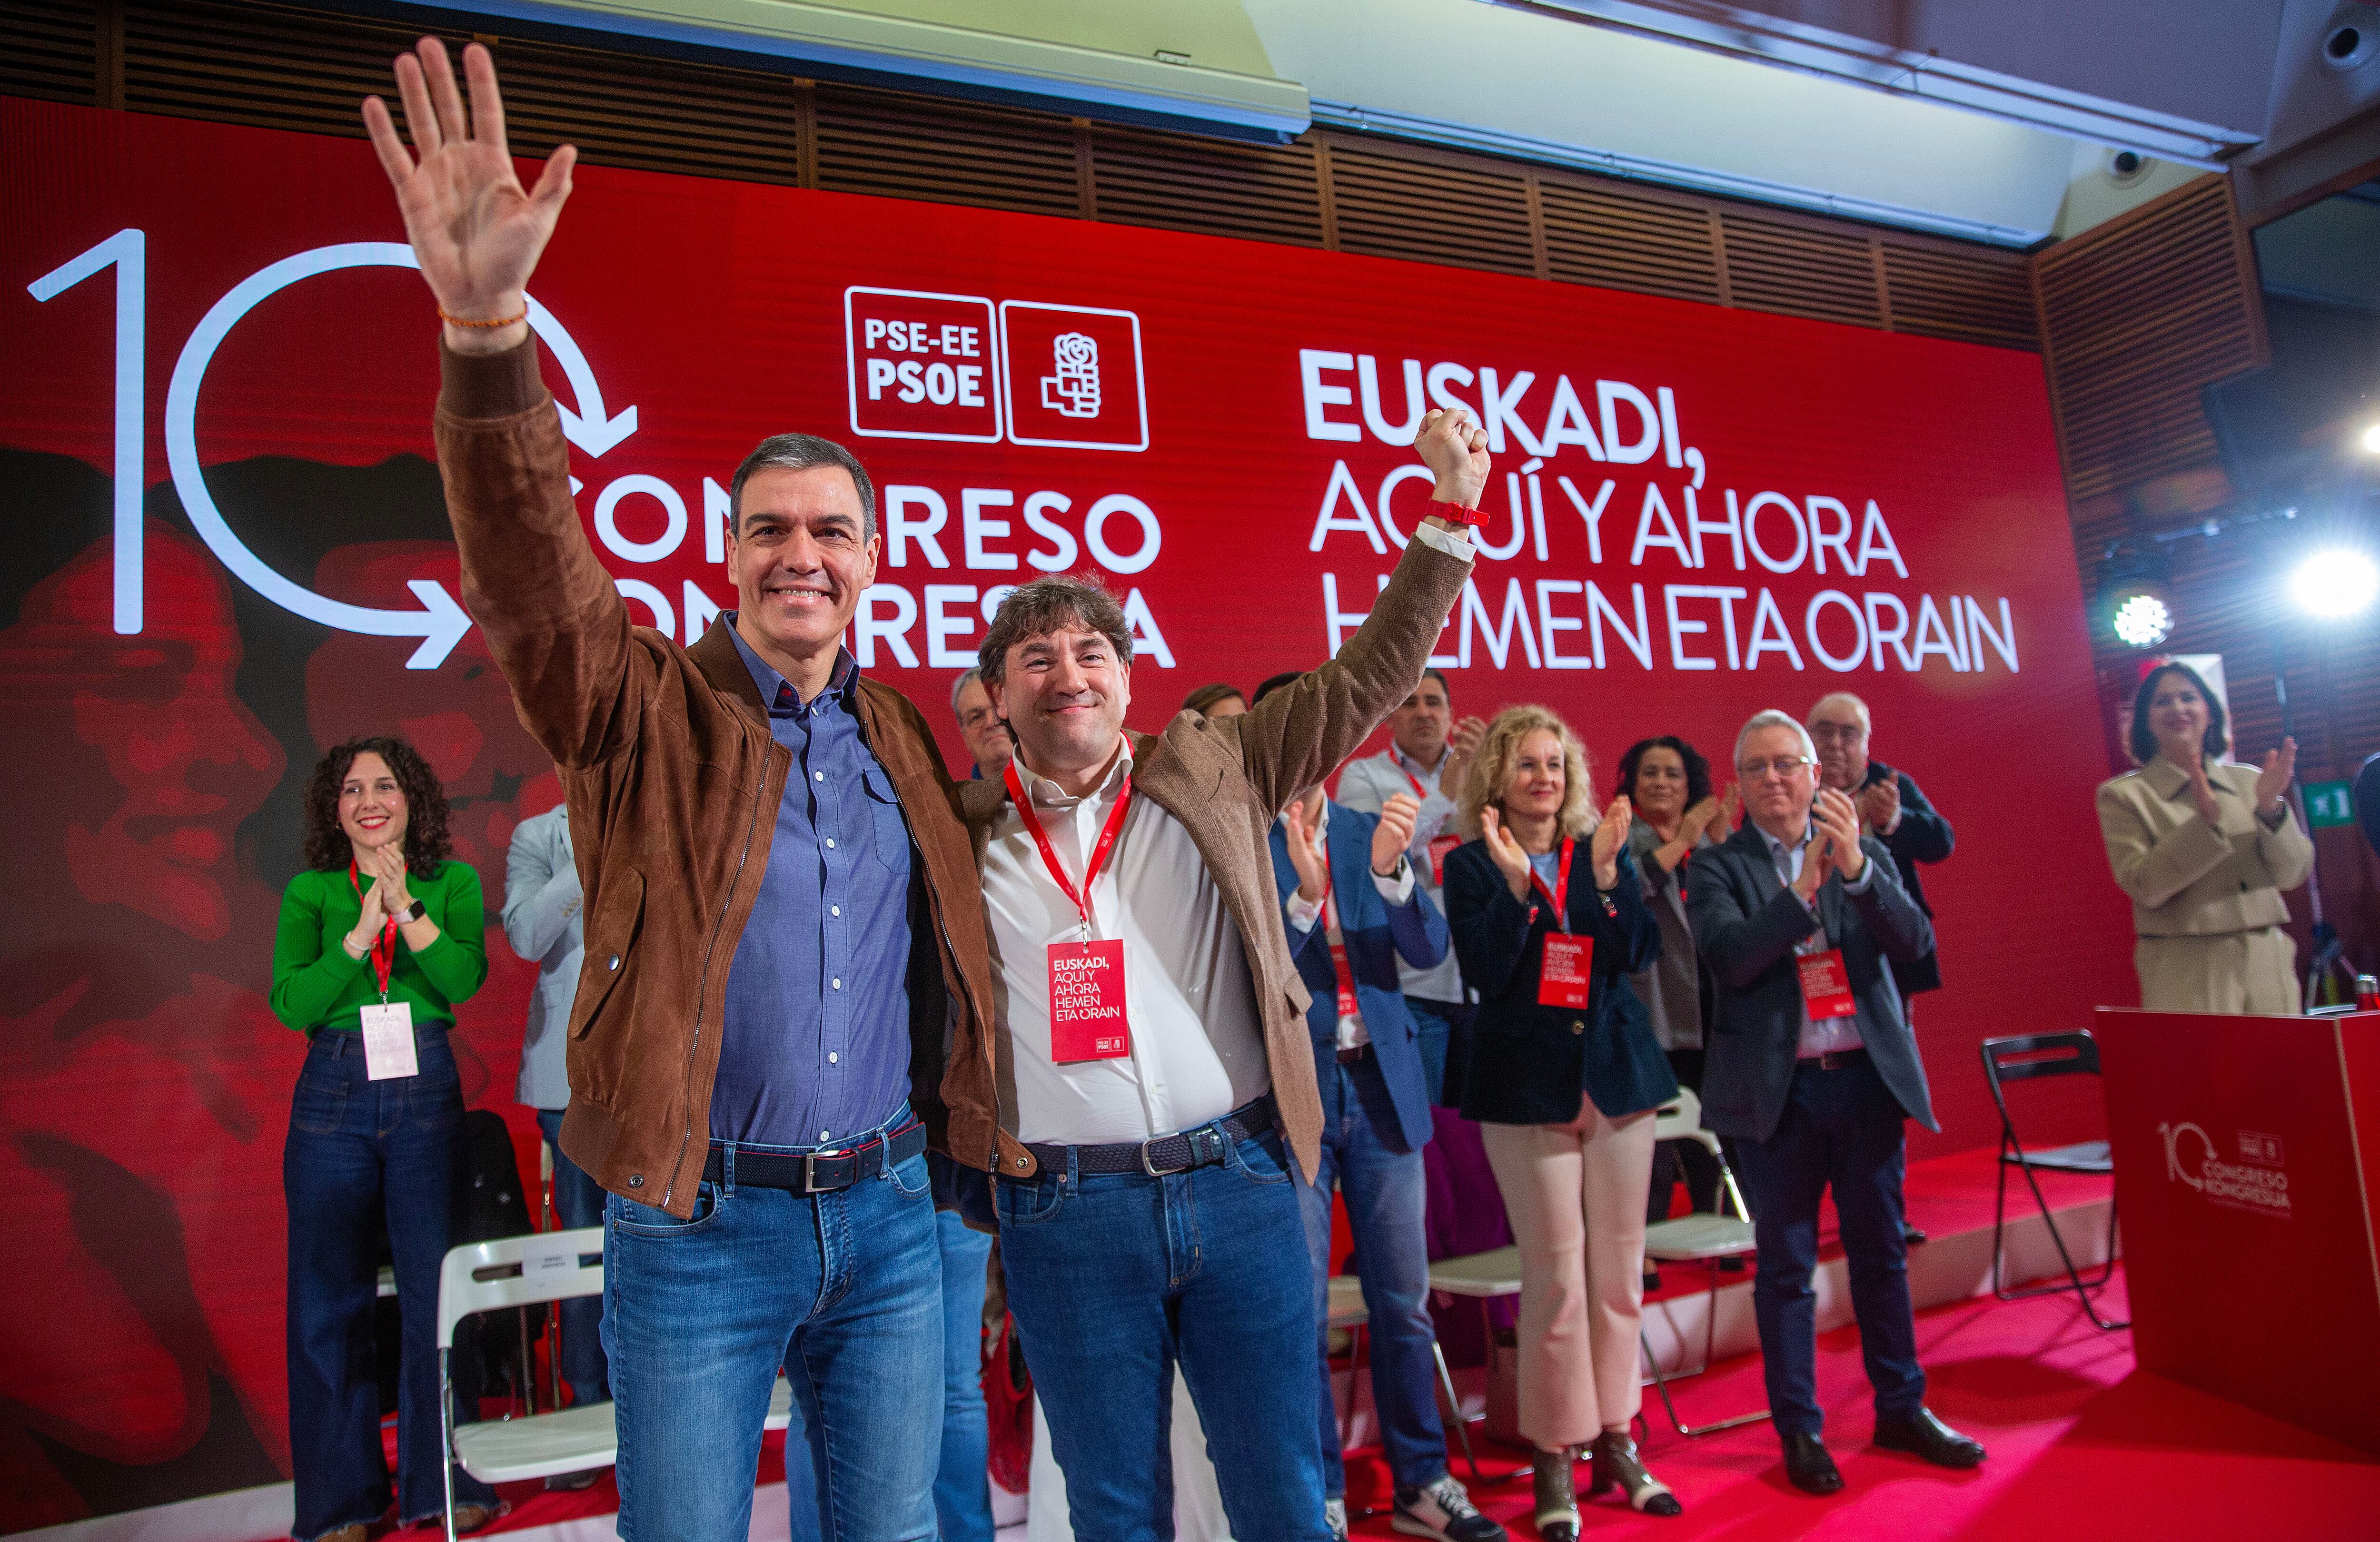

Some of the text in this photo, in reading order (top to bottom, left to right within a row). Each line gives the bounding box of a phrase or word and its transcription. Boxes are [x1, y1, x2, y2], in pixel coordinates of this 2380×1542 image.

[864, 318, 981, 358] PSE-EE
[867, 358, 986, 407] PSOE
[1299, 348, 1706, 490] EUSKADI,
[1557, 476, 1616, 564] Y
[1630, 482, 1910, 579] AHORA
[1322, 572, 2020, 673] HMEN ETA ORAIN
[1054, 957, 1110, 971] EUSKADI,
[1054, 969, 1095, 984] AQUÍ Y
[1054, 982, 1101, 997] AHORA
[1055, 995, 1101, 1009] HEMEN
[1056, 1006, 1120, 1022] ETA ORAIN
